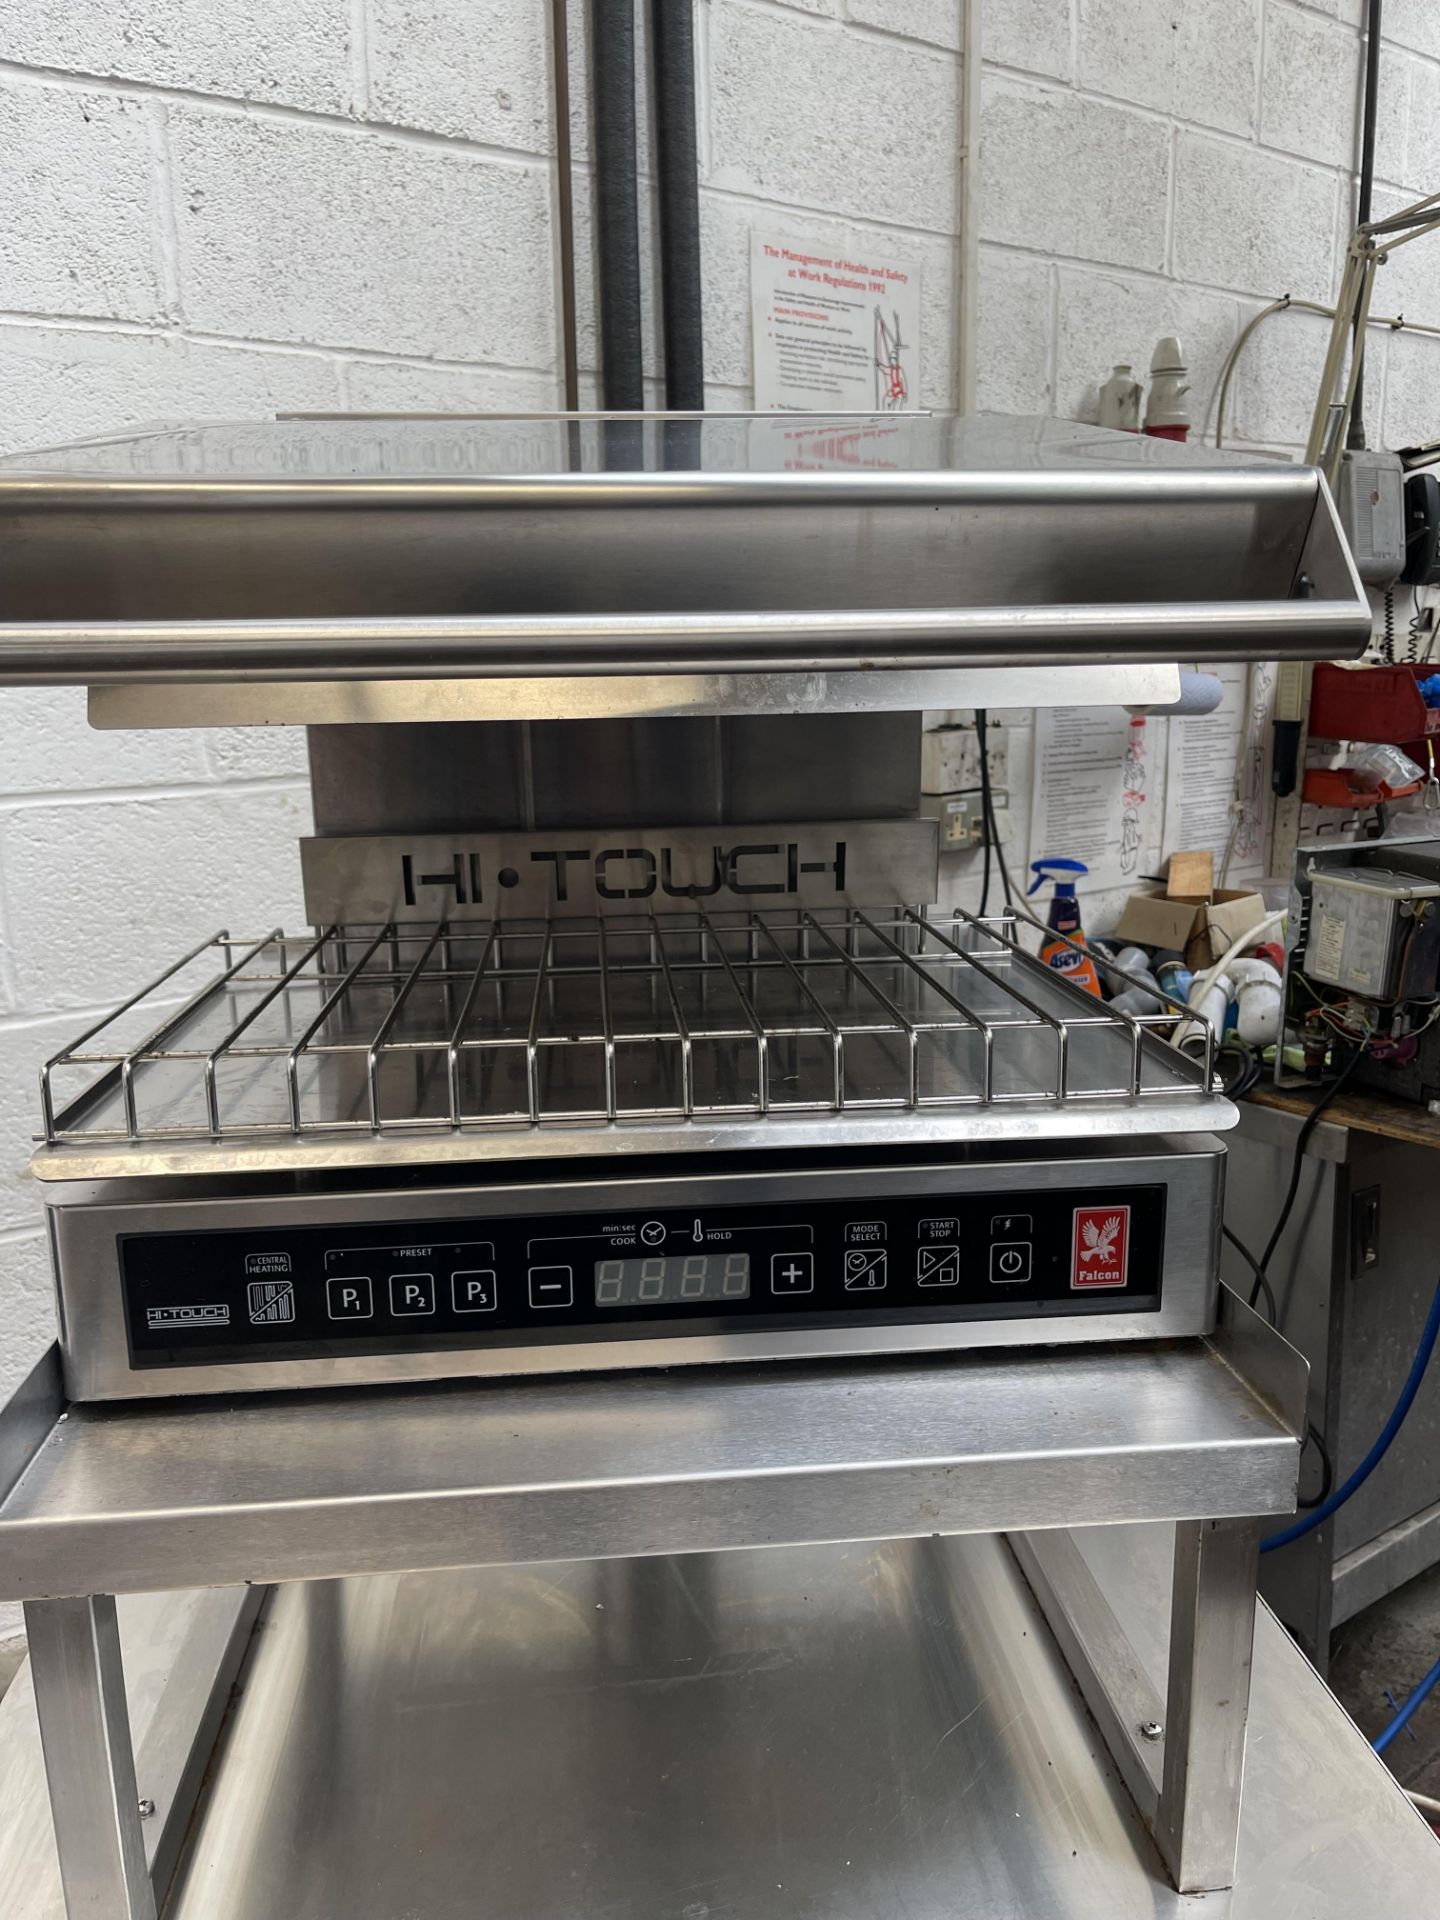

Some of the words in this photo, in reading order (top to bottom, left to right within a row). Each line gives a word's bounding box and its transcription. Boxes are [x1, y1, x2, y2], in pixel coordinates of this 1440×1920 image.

[763, 245, 780, 258] The
[781, 248, 832, 266] Management
[834, 259, 844, 269] of
[843, 261, 869, 275] Health
[871, 267, 885, 278] and
[886, 269, 908, 284] Safety
[788, 269, 796, 278] at
[798, 269, 822, 282] Work
[823, 273, 866, 288] Regulations
[852, 1225, 879, 1234] MODE
[929, 1222, 954, 1230] START
[850, 1232, 881, 1242] SELECT
[929, 1229, 951, 1238] STOP
[610, 1237, 636, 1246] COOK
[707, 1232, 732, 1240] HOLD
[400, 1249, 432, 1257] PRESET
[257, 1256, 288, 1265] CENTRAL
[249, 1265, 289, 1273] HEATING
[1079, 1270, 1120, 1281] Falcon
